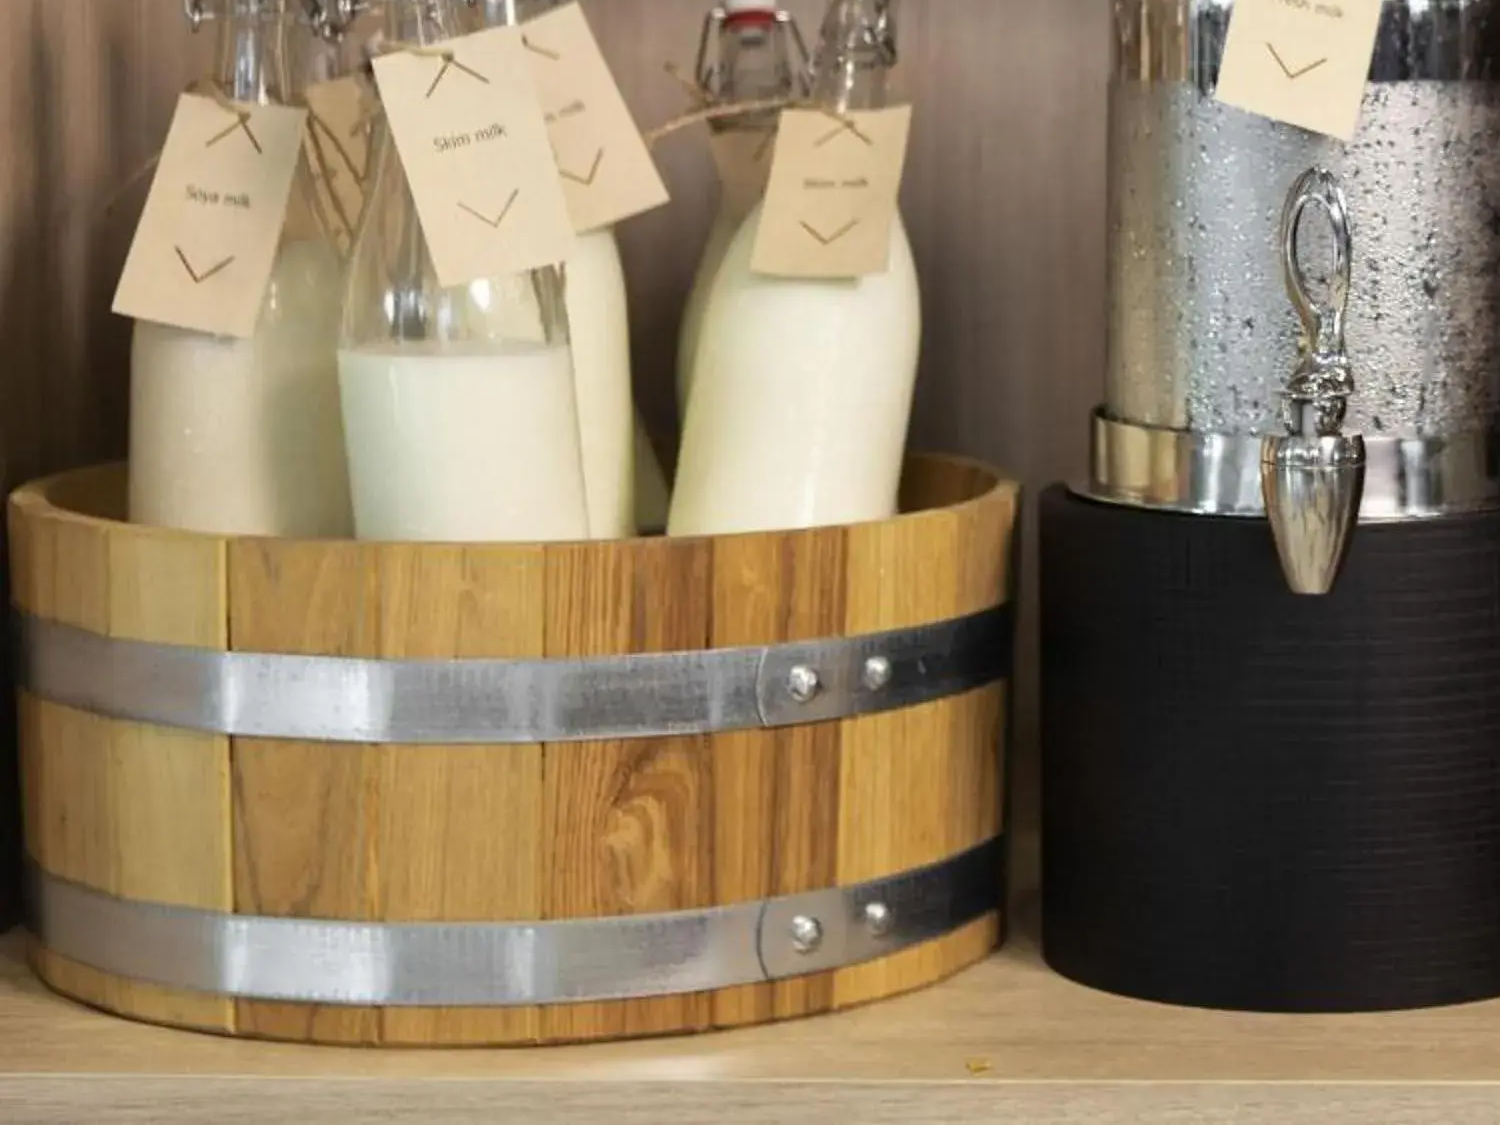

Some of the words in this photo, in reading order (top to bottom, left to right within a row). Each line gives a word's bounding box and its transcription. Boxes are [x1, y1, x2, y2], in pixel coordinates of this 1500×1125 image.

[1314, 2, 1344, 19] milk
[433, 133, 470, 153] Skim
[475, 122, 507, 142] milk
[184, 183, 219, 207] Soya
[223, 192, 250, 210] milk
